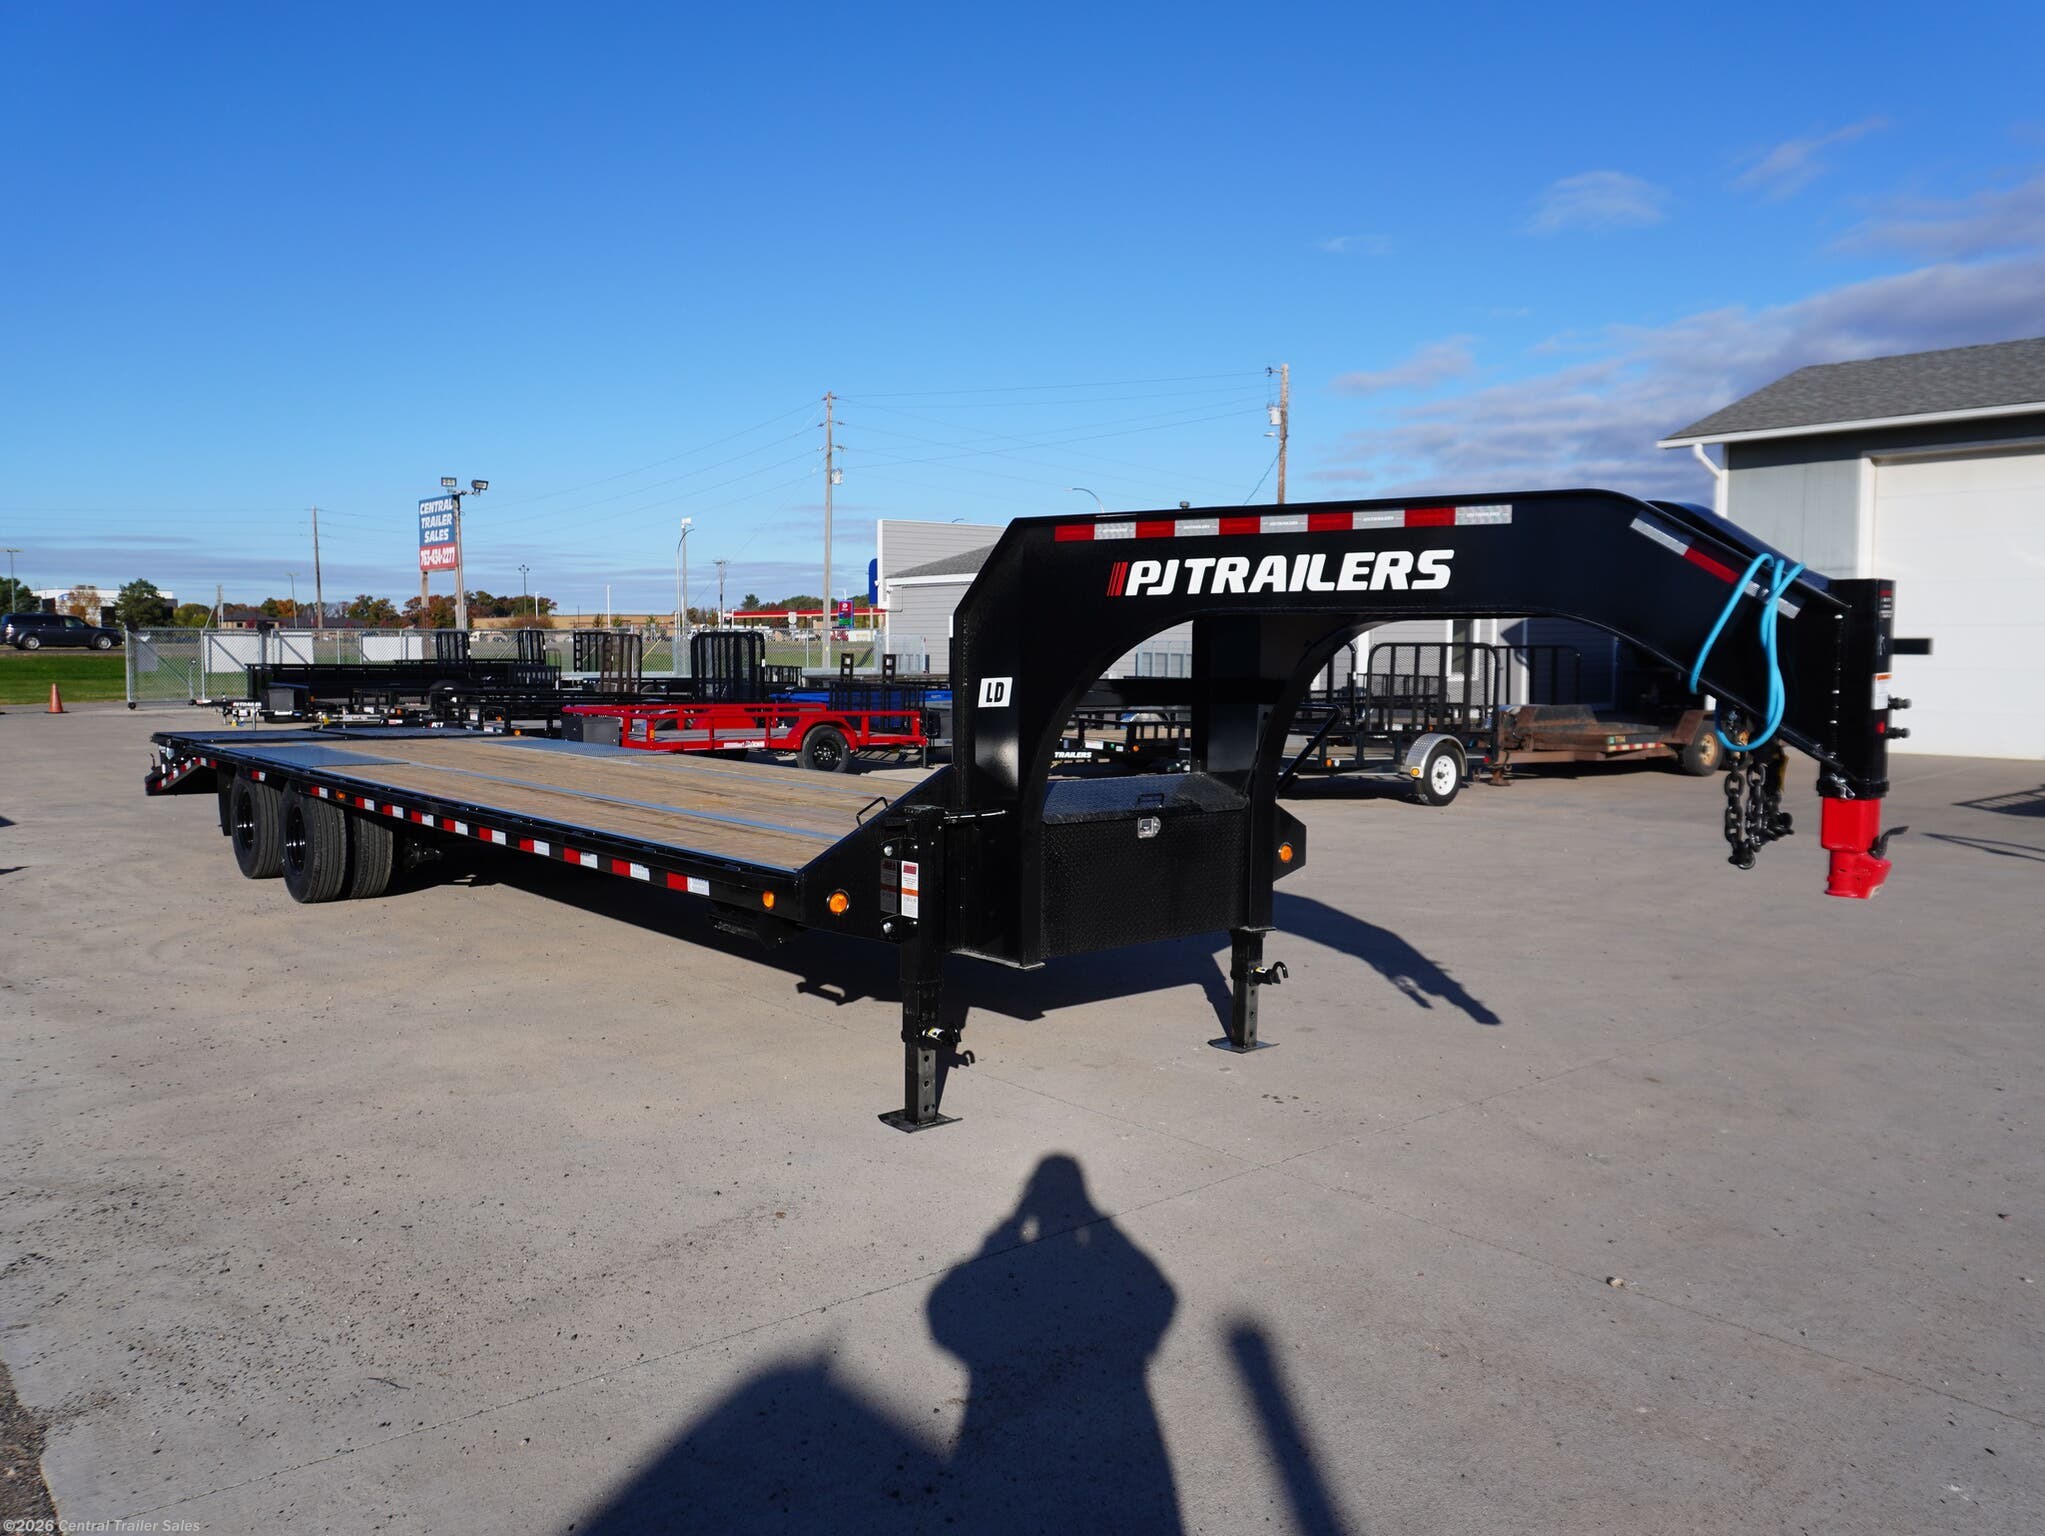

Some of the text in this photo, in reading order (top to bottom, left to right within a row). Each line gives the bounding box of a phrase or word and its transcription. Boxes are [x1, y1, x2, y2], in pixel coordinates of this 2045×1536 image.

[420, 499, 453, 514] CENTRAL
[421, 513, 452, 529] TRAILER
[424, 528, 449, 543] SALES
[1125, 549, 1454, 596] PJ TRAILERS
[986, 682, 1005, 703] LD
[1054, 751, 1092, 759] TRAILERS
